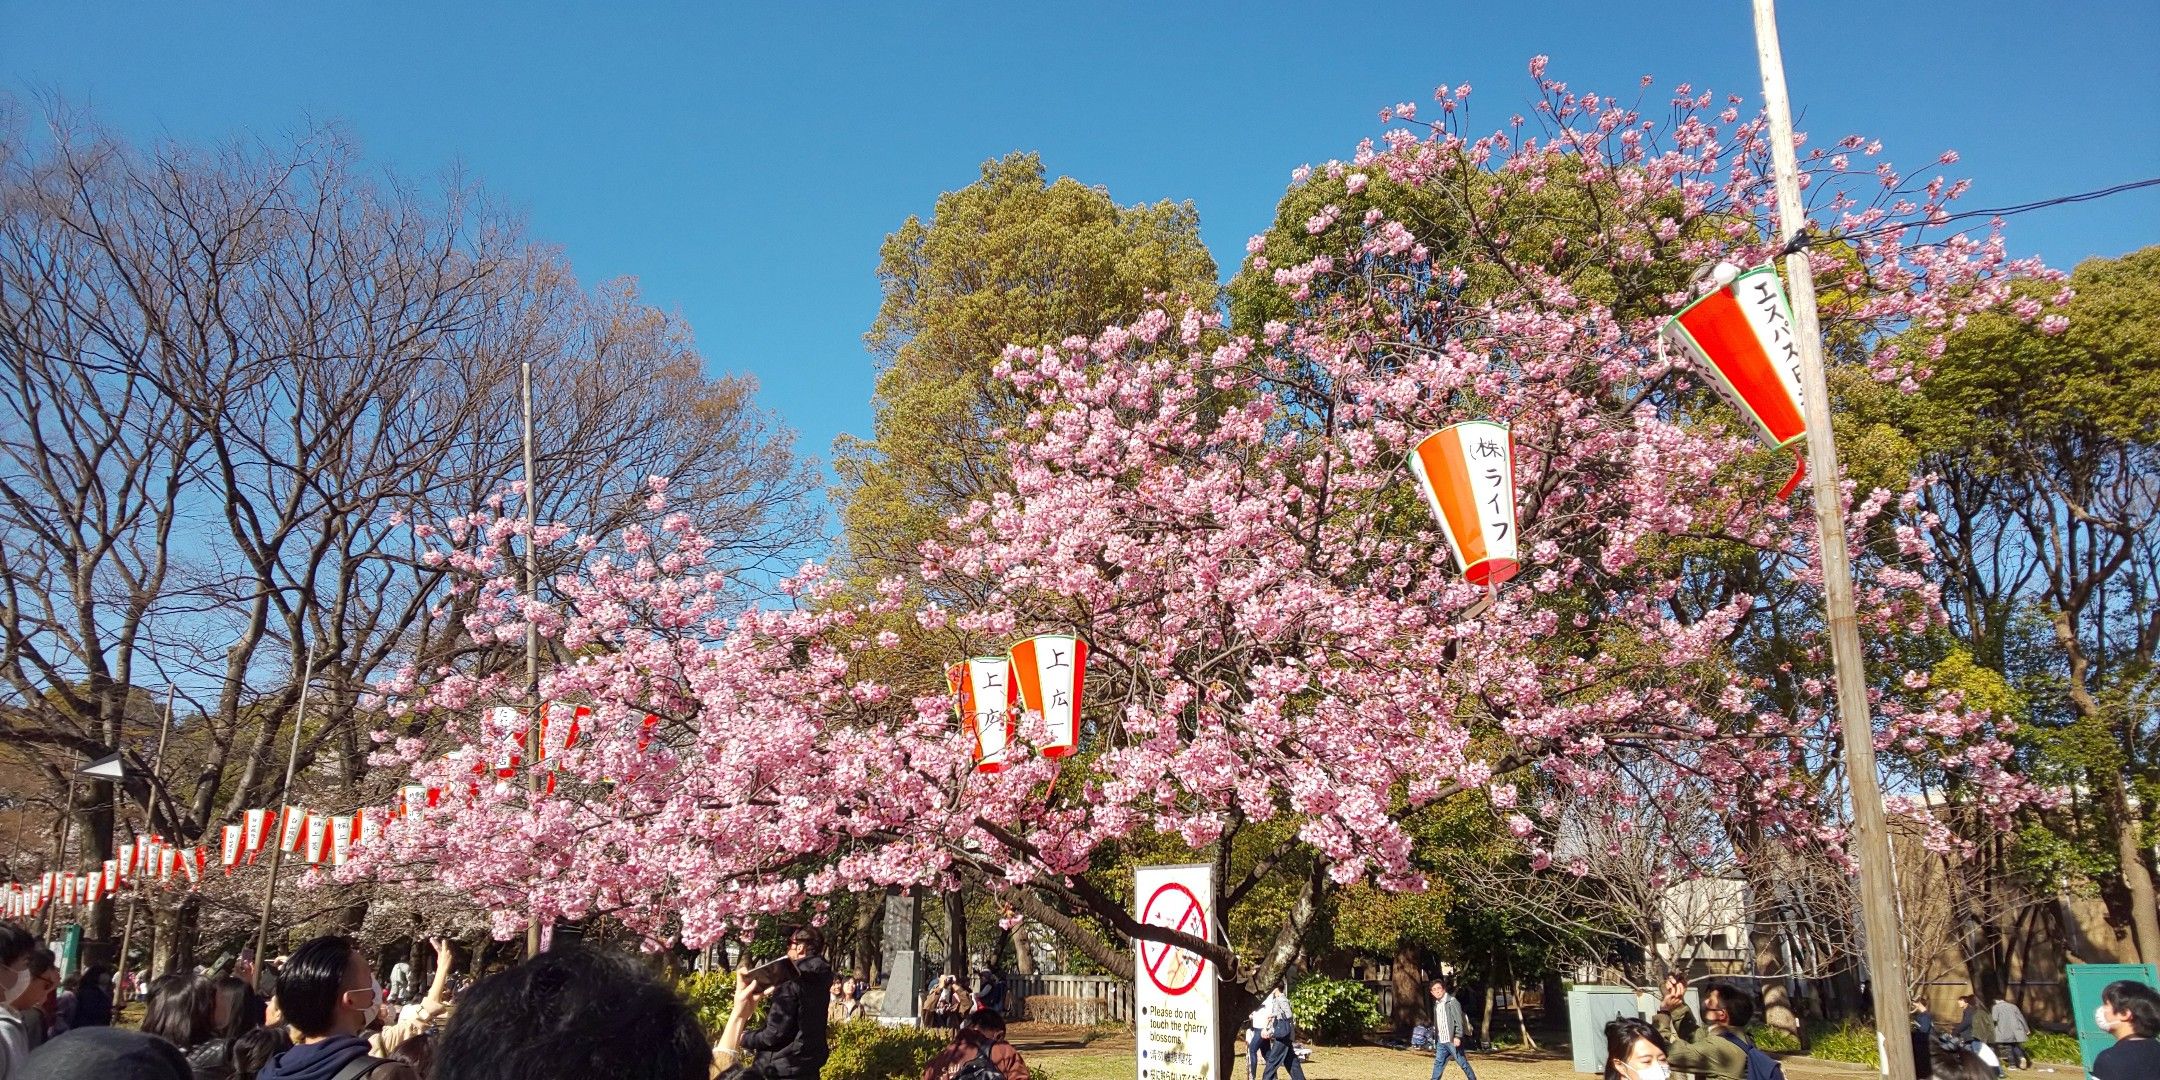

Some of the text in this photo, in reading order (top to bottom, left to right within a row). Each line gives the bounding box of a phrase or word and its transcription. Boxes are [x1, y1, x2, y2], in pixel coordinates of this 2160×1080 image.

[1469, 436, 1509, 542] (株)ライフ
[1150, 1005, 1197, 1020] Please do not
[1150, 1018, 1208, 1036] touch the cherry
